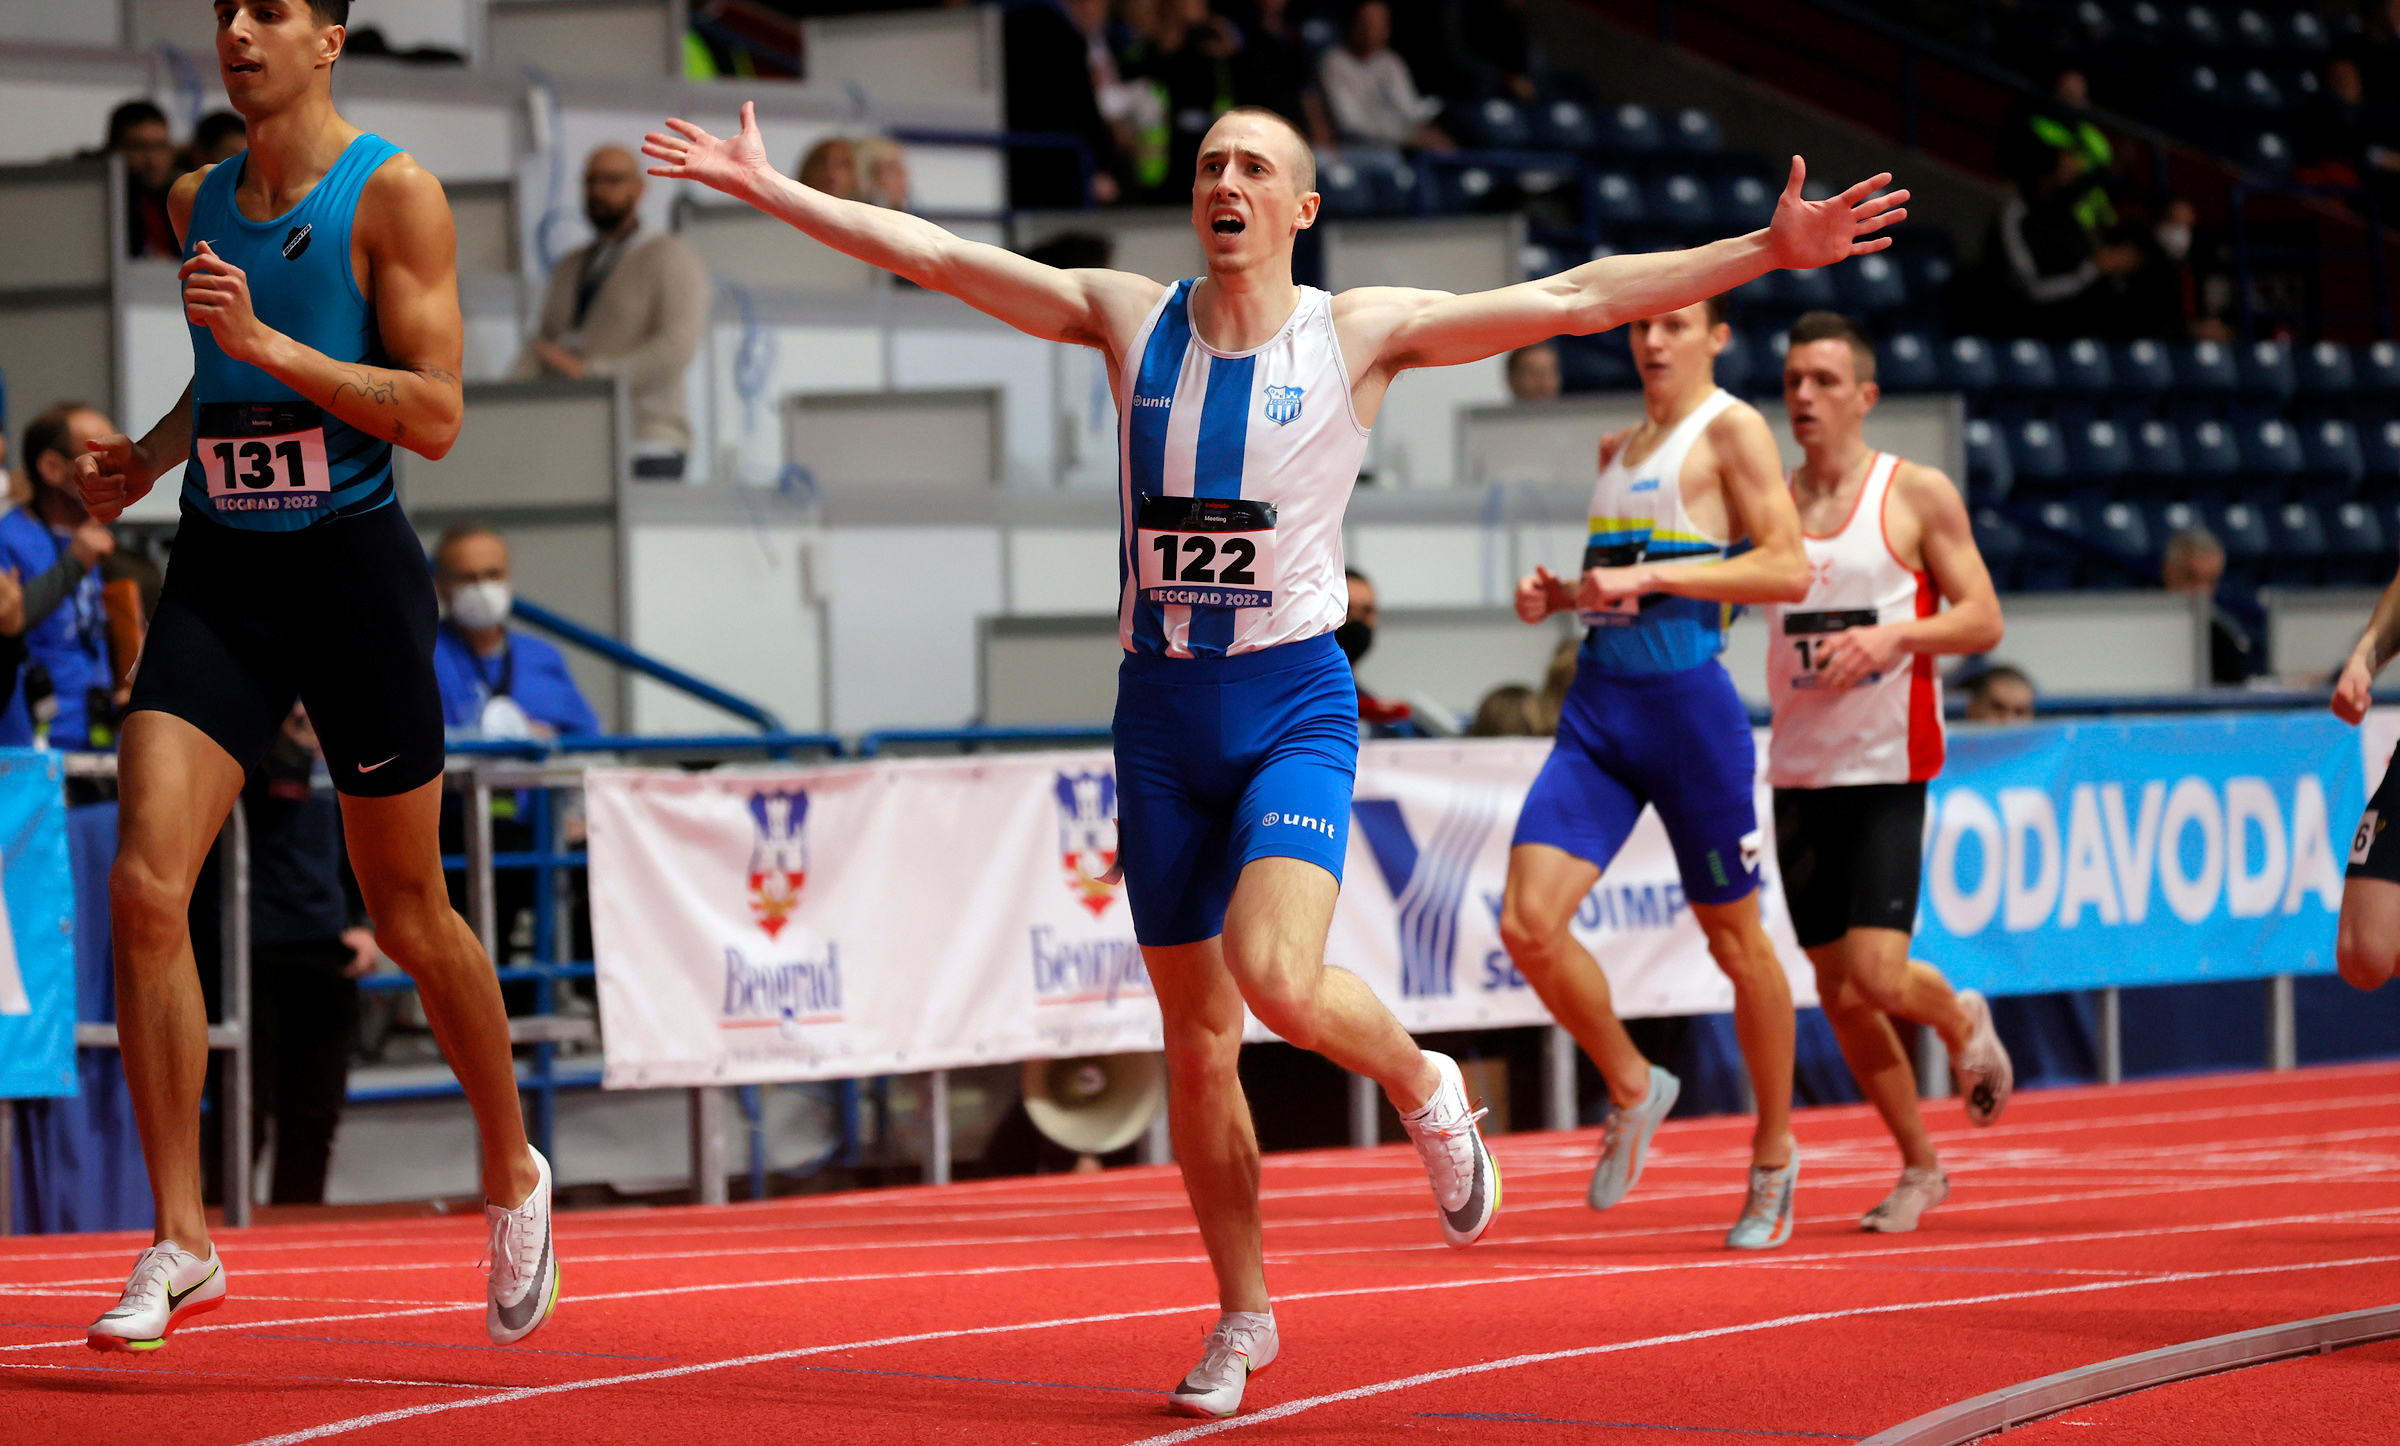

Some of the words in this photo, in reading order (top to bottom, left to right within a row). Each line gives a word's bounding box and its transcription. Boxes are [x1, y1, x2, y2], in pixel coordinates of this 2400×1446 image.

[1142, 396, 1171, 408] unit
[213, 440, 306, 489] 131
[283, 495, 318, 509] 2022
[1204, 515, 1227, 523] Meeting
[1153, 535, 1256, 585] 122
[1149, 589, 1222, 606] BEOGRAD
[1225, 593, 1259, 606] 2022
[1283, 813, 1335, 840] unit
[2354, 822, 2371, 854] 6
[1913, 774, 2345, 938] ODAVODA
